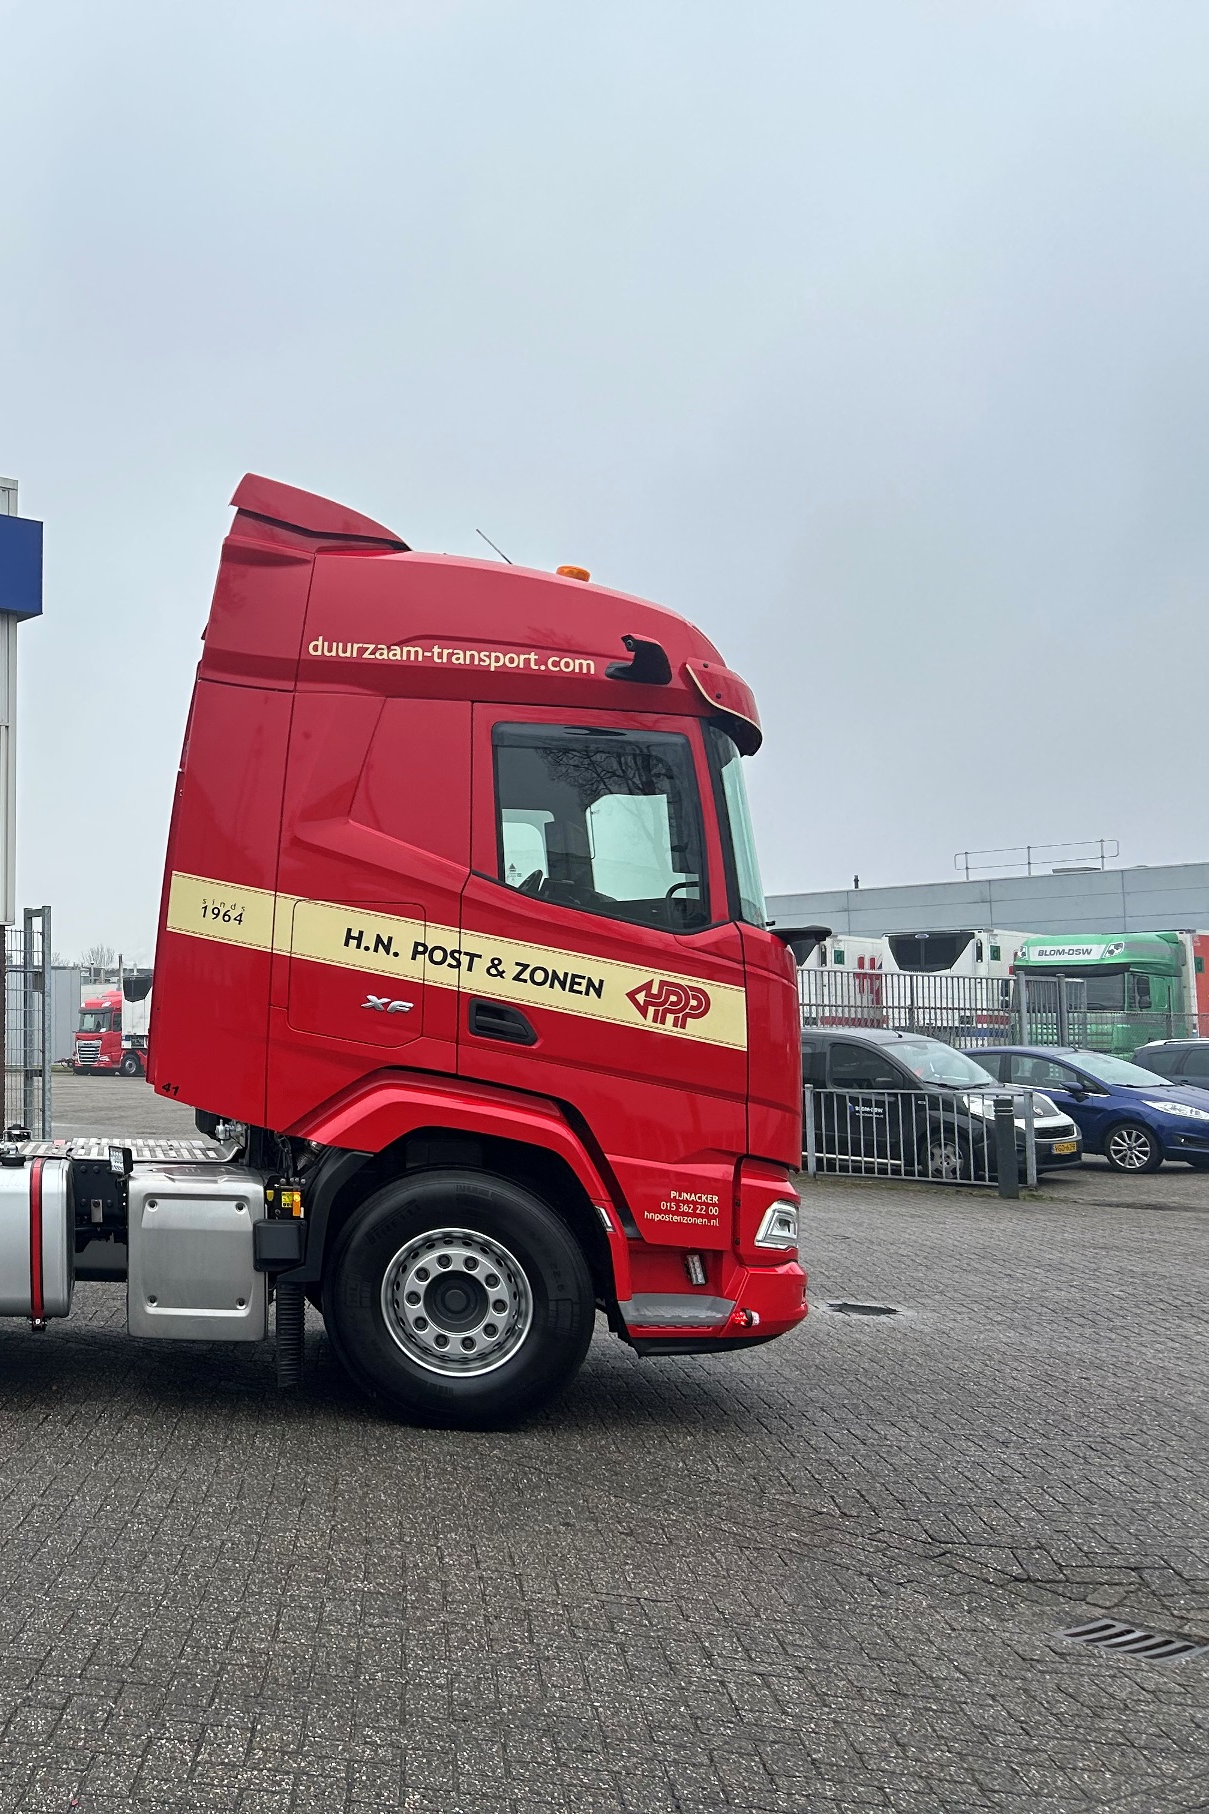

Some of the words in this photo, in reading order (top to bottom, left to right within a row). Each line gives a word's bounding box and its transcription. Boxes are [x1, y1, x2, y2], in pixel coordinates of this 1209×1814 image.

[308, 636, 595, 675] duurzaam-transport.com
[202, 899, 246, 912] sinds
[201, 905, 244, 925] 1964
[1037, 948, 1093, 957] BLOM-DSW
[343, 927, 400, 958] H.N.
[410, 941, 482, 972] POST
[486, 957, 506, 979] &
[512, 961, 605, 999] ZONEN
[360, 994, 415, 1014] XF
[161, 1082, 180, 1097] 41
[670, 1191, 719, 1203] PIJNACKER
[660, 1201, 676, 1211] 015
[678, 1203, 694, 1213] 362
[695, 1205, 706, 1215] 22
[708, 1206, 719, 1216] 00
[644, 1211, 719, 1226] hnpostenzonen.nl
